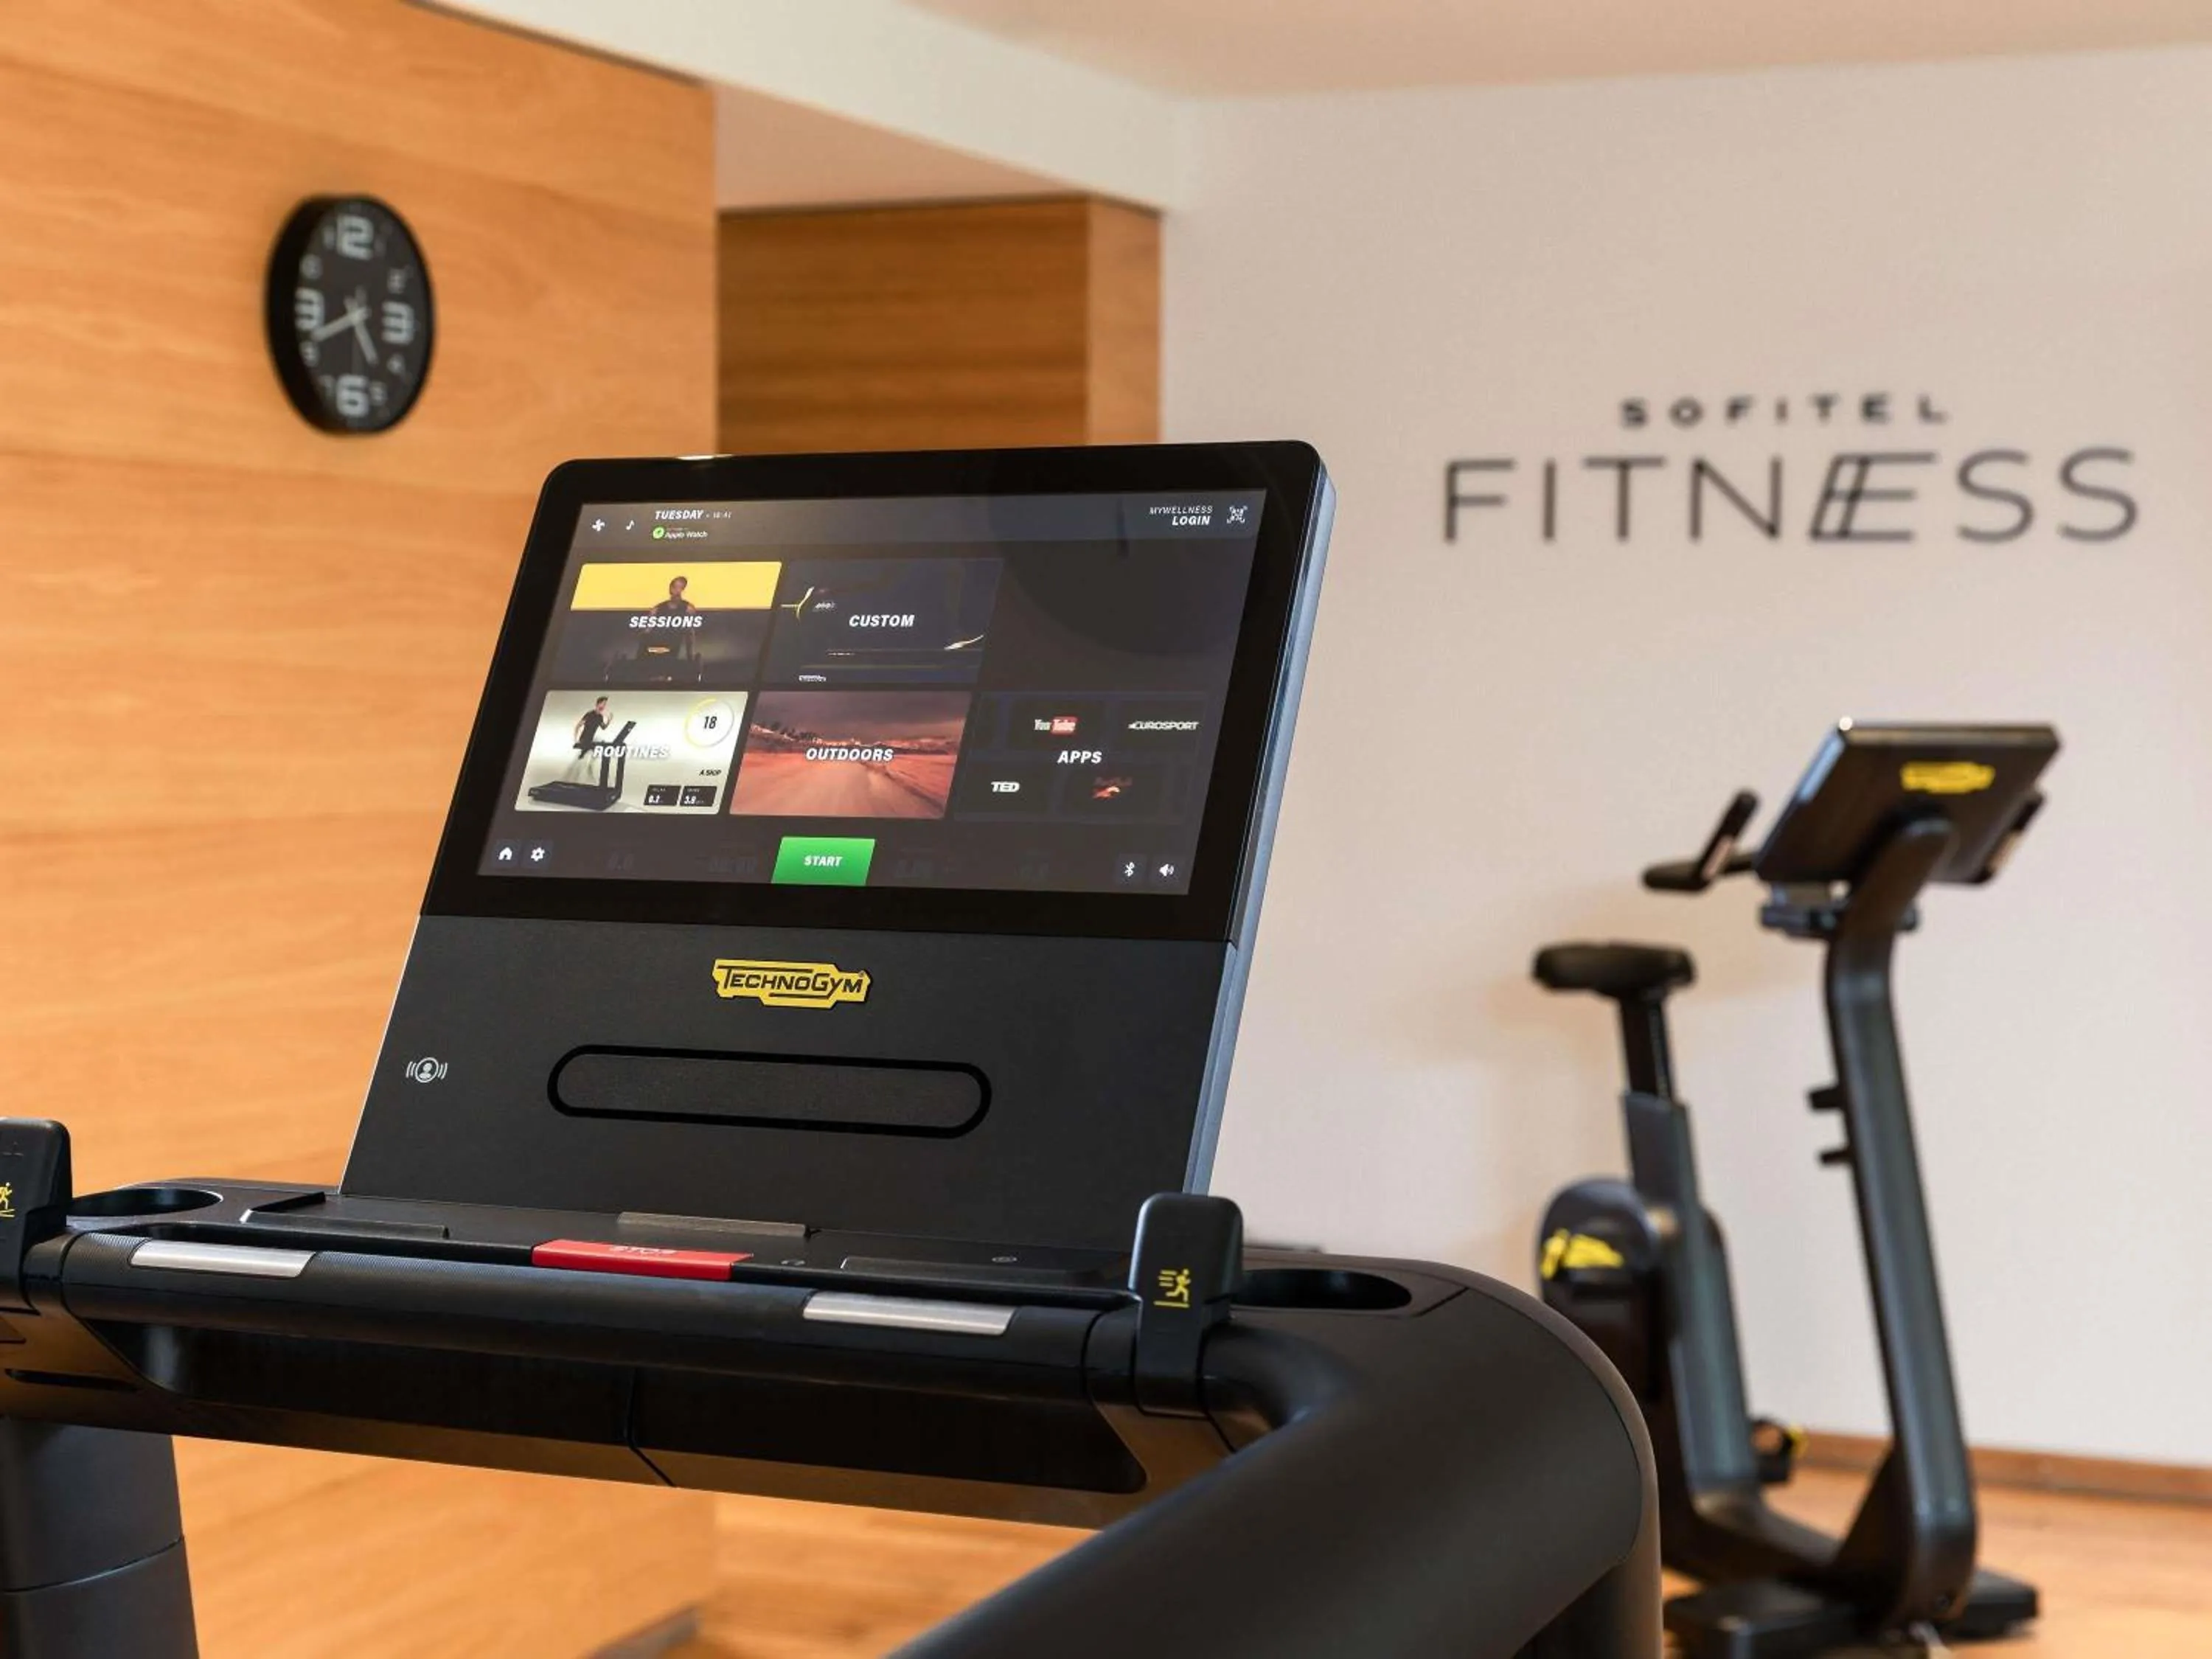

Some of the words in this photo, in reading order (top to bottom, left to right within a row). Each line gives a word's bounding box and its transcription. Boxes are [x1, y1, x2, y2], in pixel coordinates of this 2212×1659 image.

[381, 300, 414, 346] 3
[336, 374, 369, 417] 6
[1619, 392, 1948, 428] SOFITEL
[1442, 447, 2140, 543] FITNESS
[655, 509, 704, 521] TUESDAY
[1150, 505, 1213, 515] MYWELLNESS
[1172, 515, 1211, 526] LOGIN
[629, 615, 703, 628] SESSIONS
[849, 614, 915, 627] CUSTOM
[703, 716, 717, 729] 18
[592, 745, 669, 759] ROUTINES
[805, 748, 894, 762] OUTDOORS
[1057, 751, 1102, 764] APPS
[990, 782, 1020, 793] TED
[804, 855, 843, 866] START
